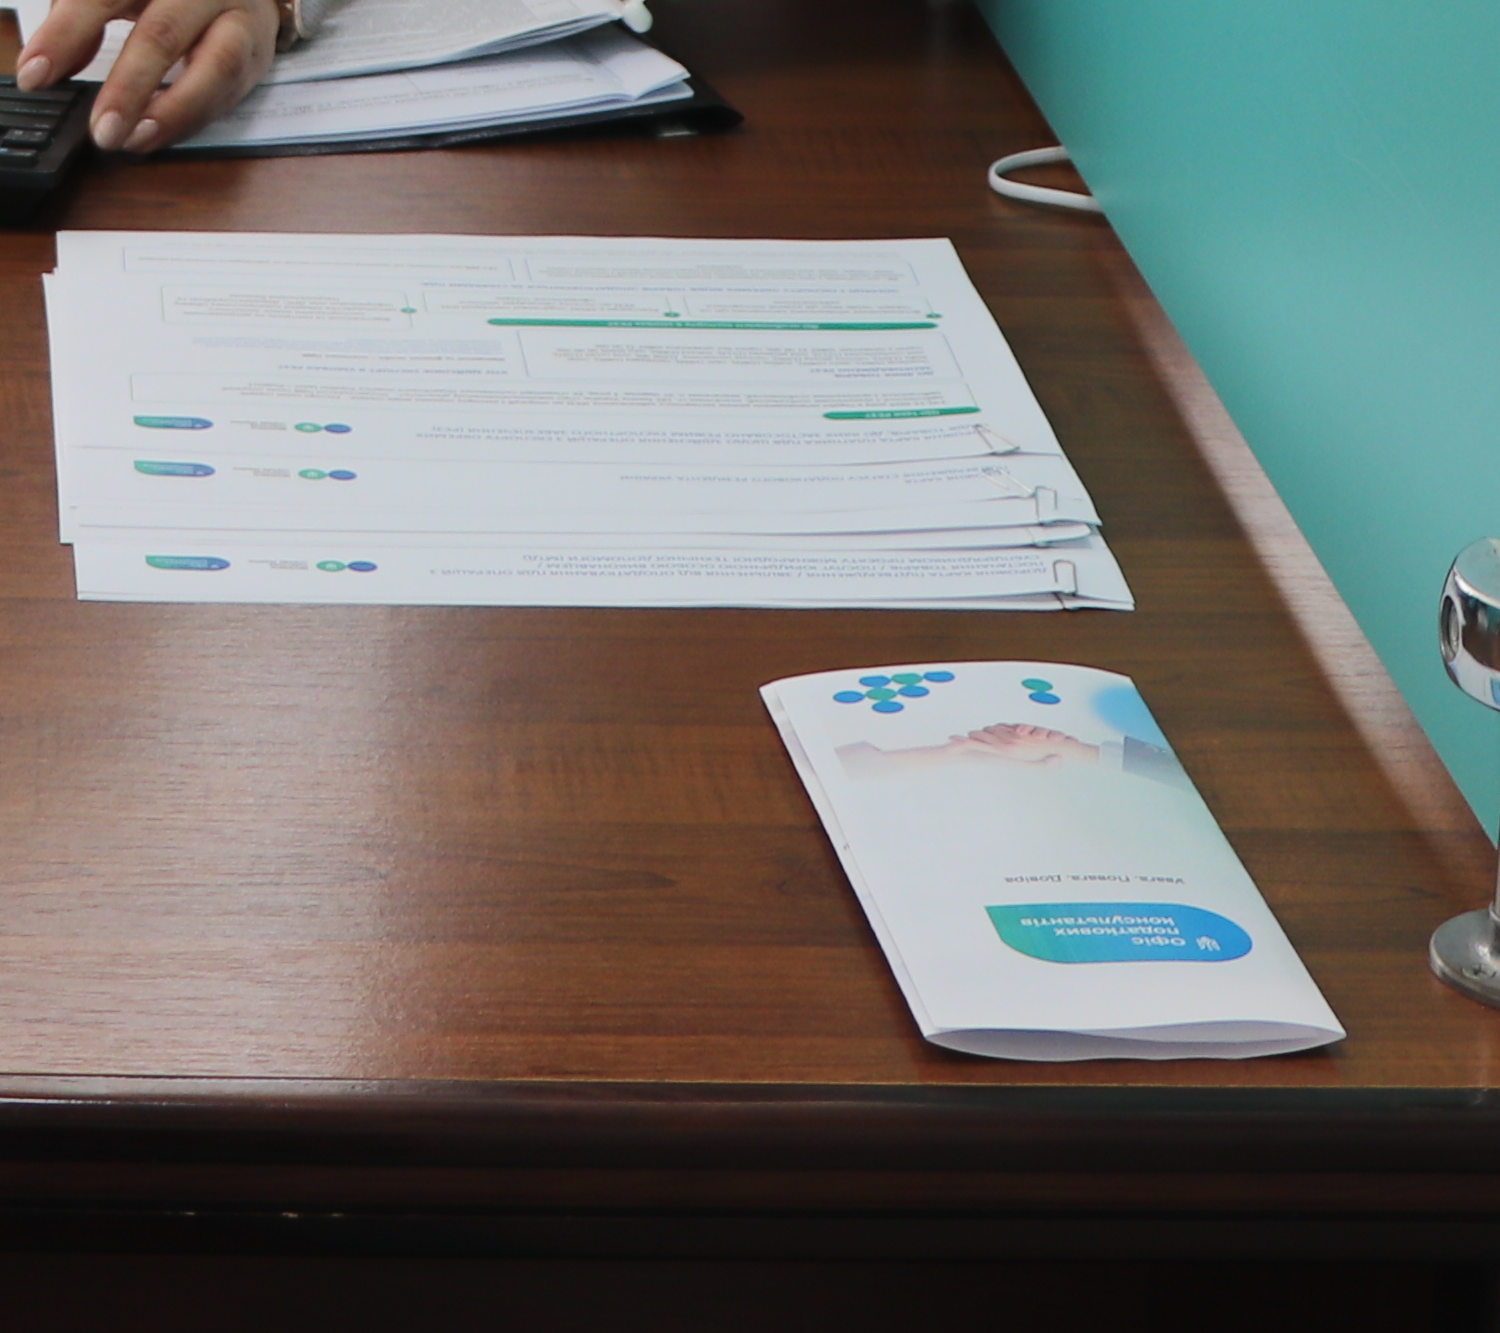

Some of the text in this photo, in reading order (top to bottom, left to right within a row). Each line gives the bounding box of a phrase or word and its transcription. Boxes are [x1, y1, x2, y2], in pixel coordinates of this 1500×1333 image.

[1005, 874, 1062, 885] Довіра
[1020, 915, 1176, 928] консультантів
[1053, 926, 1180, 937] податкових
[1131, 935, 1187, 947] Офіс
